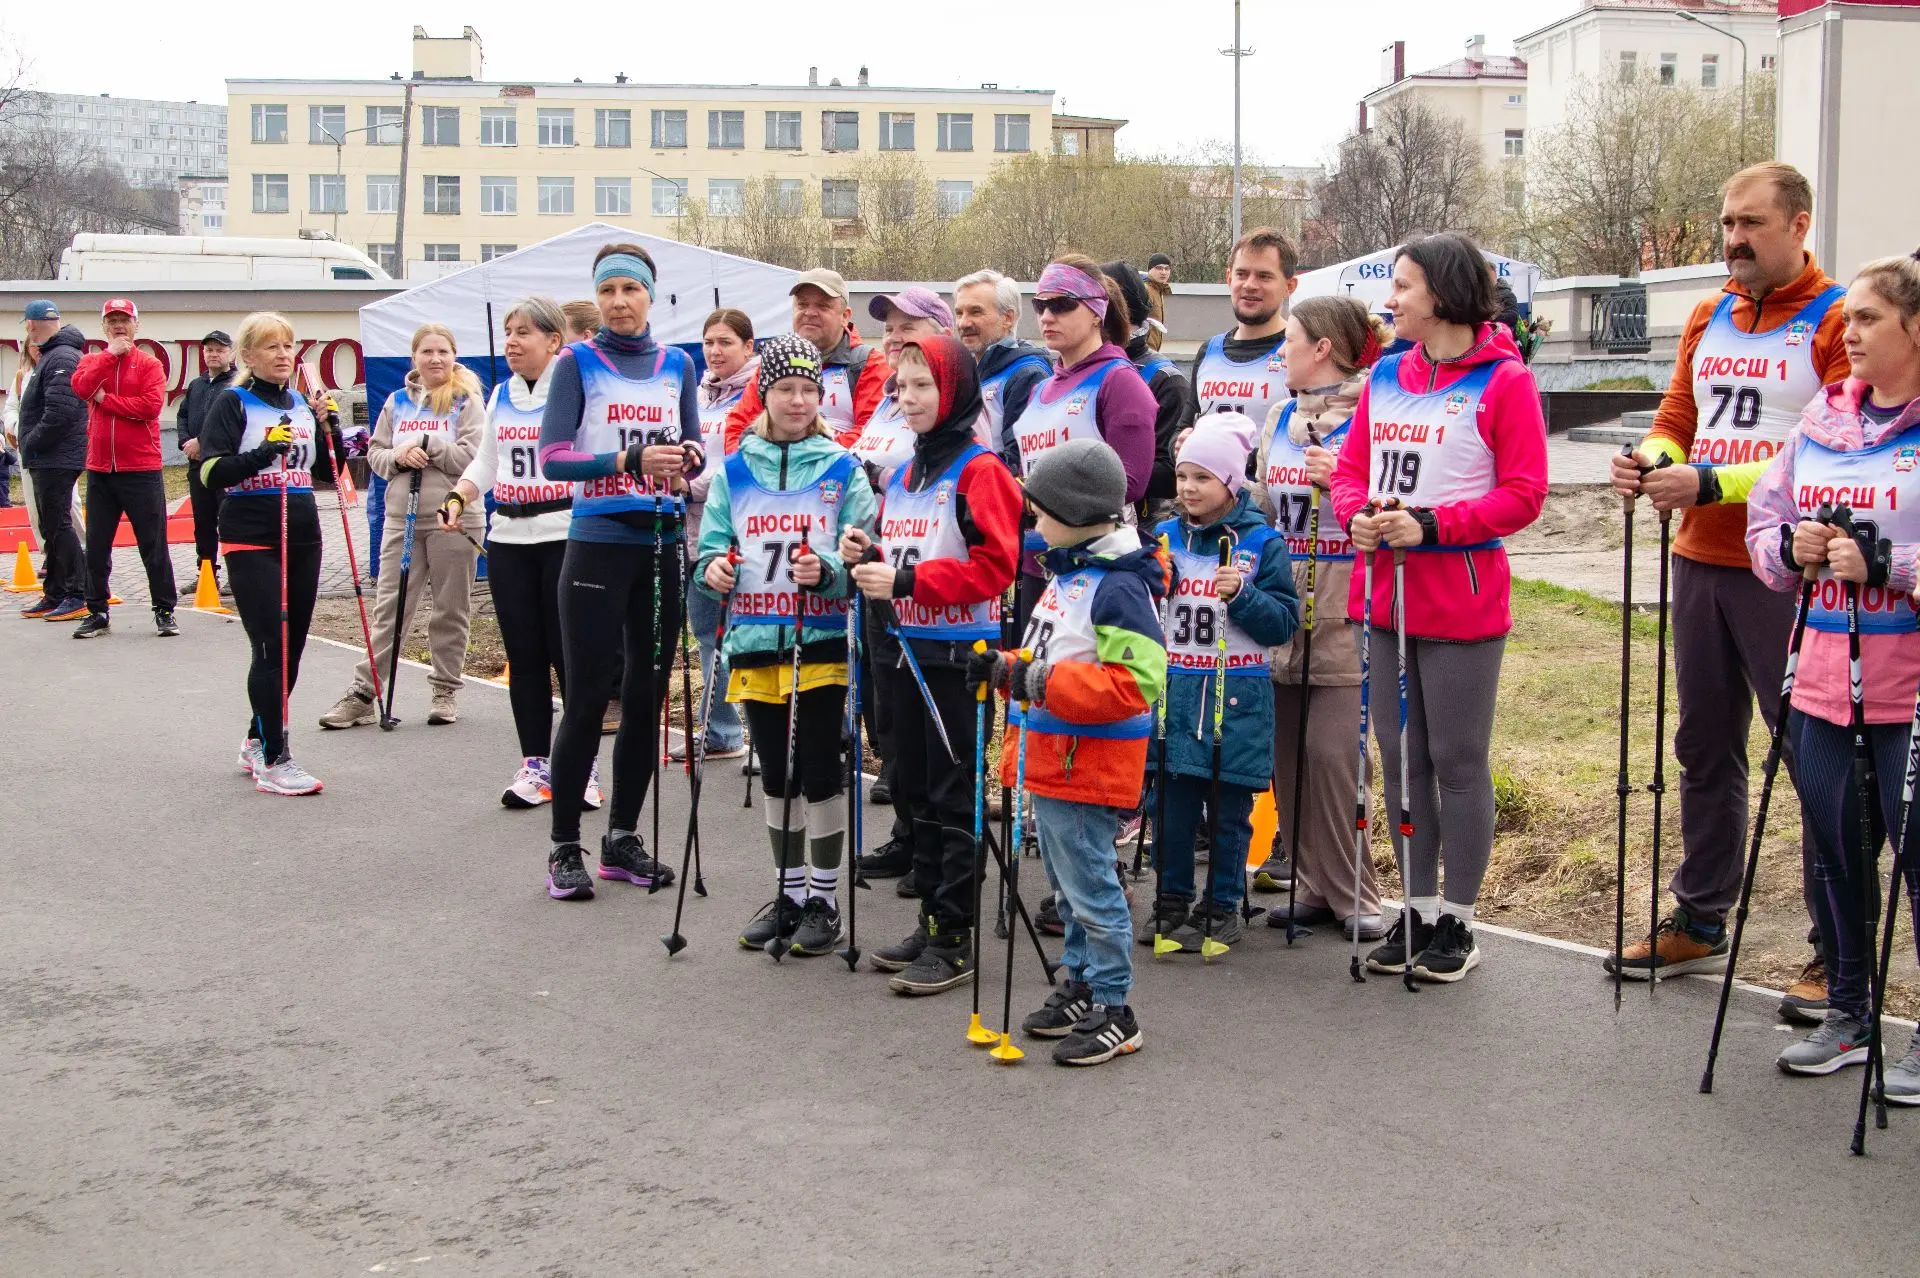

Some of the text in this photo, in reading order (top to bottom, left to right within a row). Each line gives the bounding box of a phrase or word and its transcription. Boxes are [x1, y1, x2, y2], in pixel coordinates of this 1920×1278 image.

[1697, 357, 1787, 382] ДЮСШ 1
[1201, 381, 1269, 400] ДЮСШ 1
[607, 404, 674, 424] ДЮСШ 1
[1706, 385, 1762, 430] 70
[399, 420, 449, 433] ДЮСШ 1
[498, 426, 541, 442] ДЮСШ
[1373, 423, 1445, 444] ДЮСШ 1
[1021, 427, 1069, 456] ДЮСШ 1
[511, 446, 536, 479] 61
[1378, 450, 1422, 496] 119
[1799, 485, 1897, 512] ДЮСШ 1
[1280, 491, 1311, 533] 47
[746, 514, 827, 538] ДЮСШ 1
[882, 519, 928, 541] ДЮСШ
[1022, 616, 1054, 660] 78
[1174, 604, 1216, 648] 38
